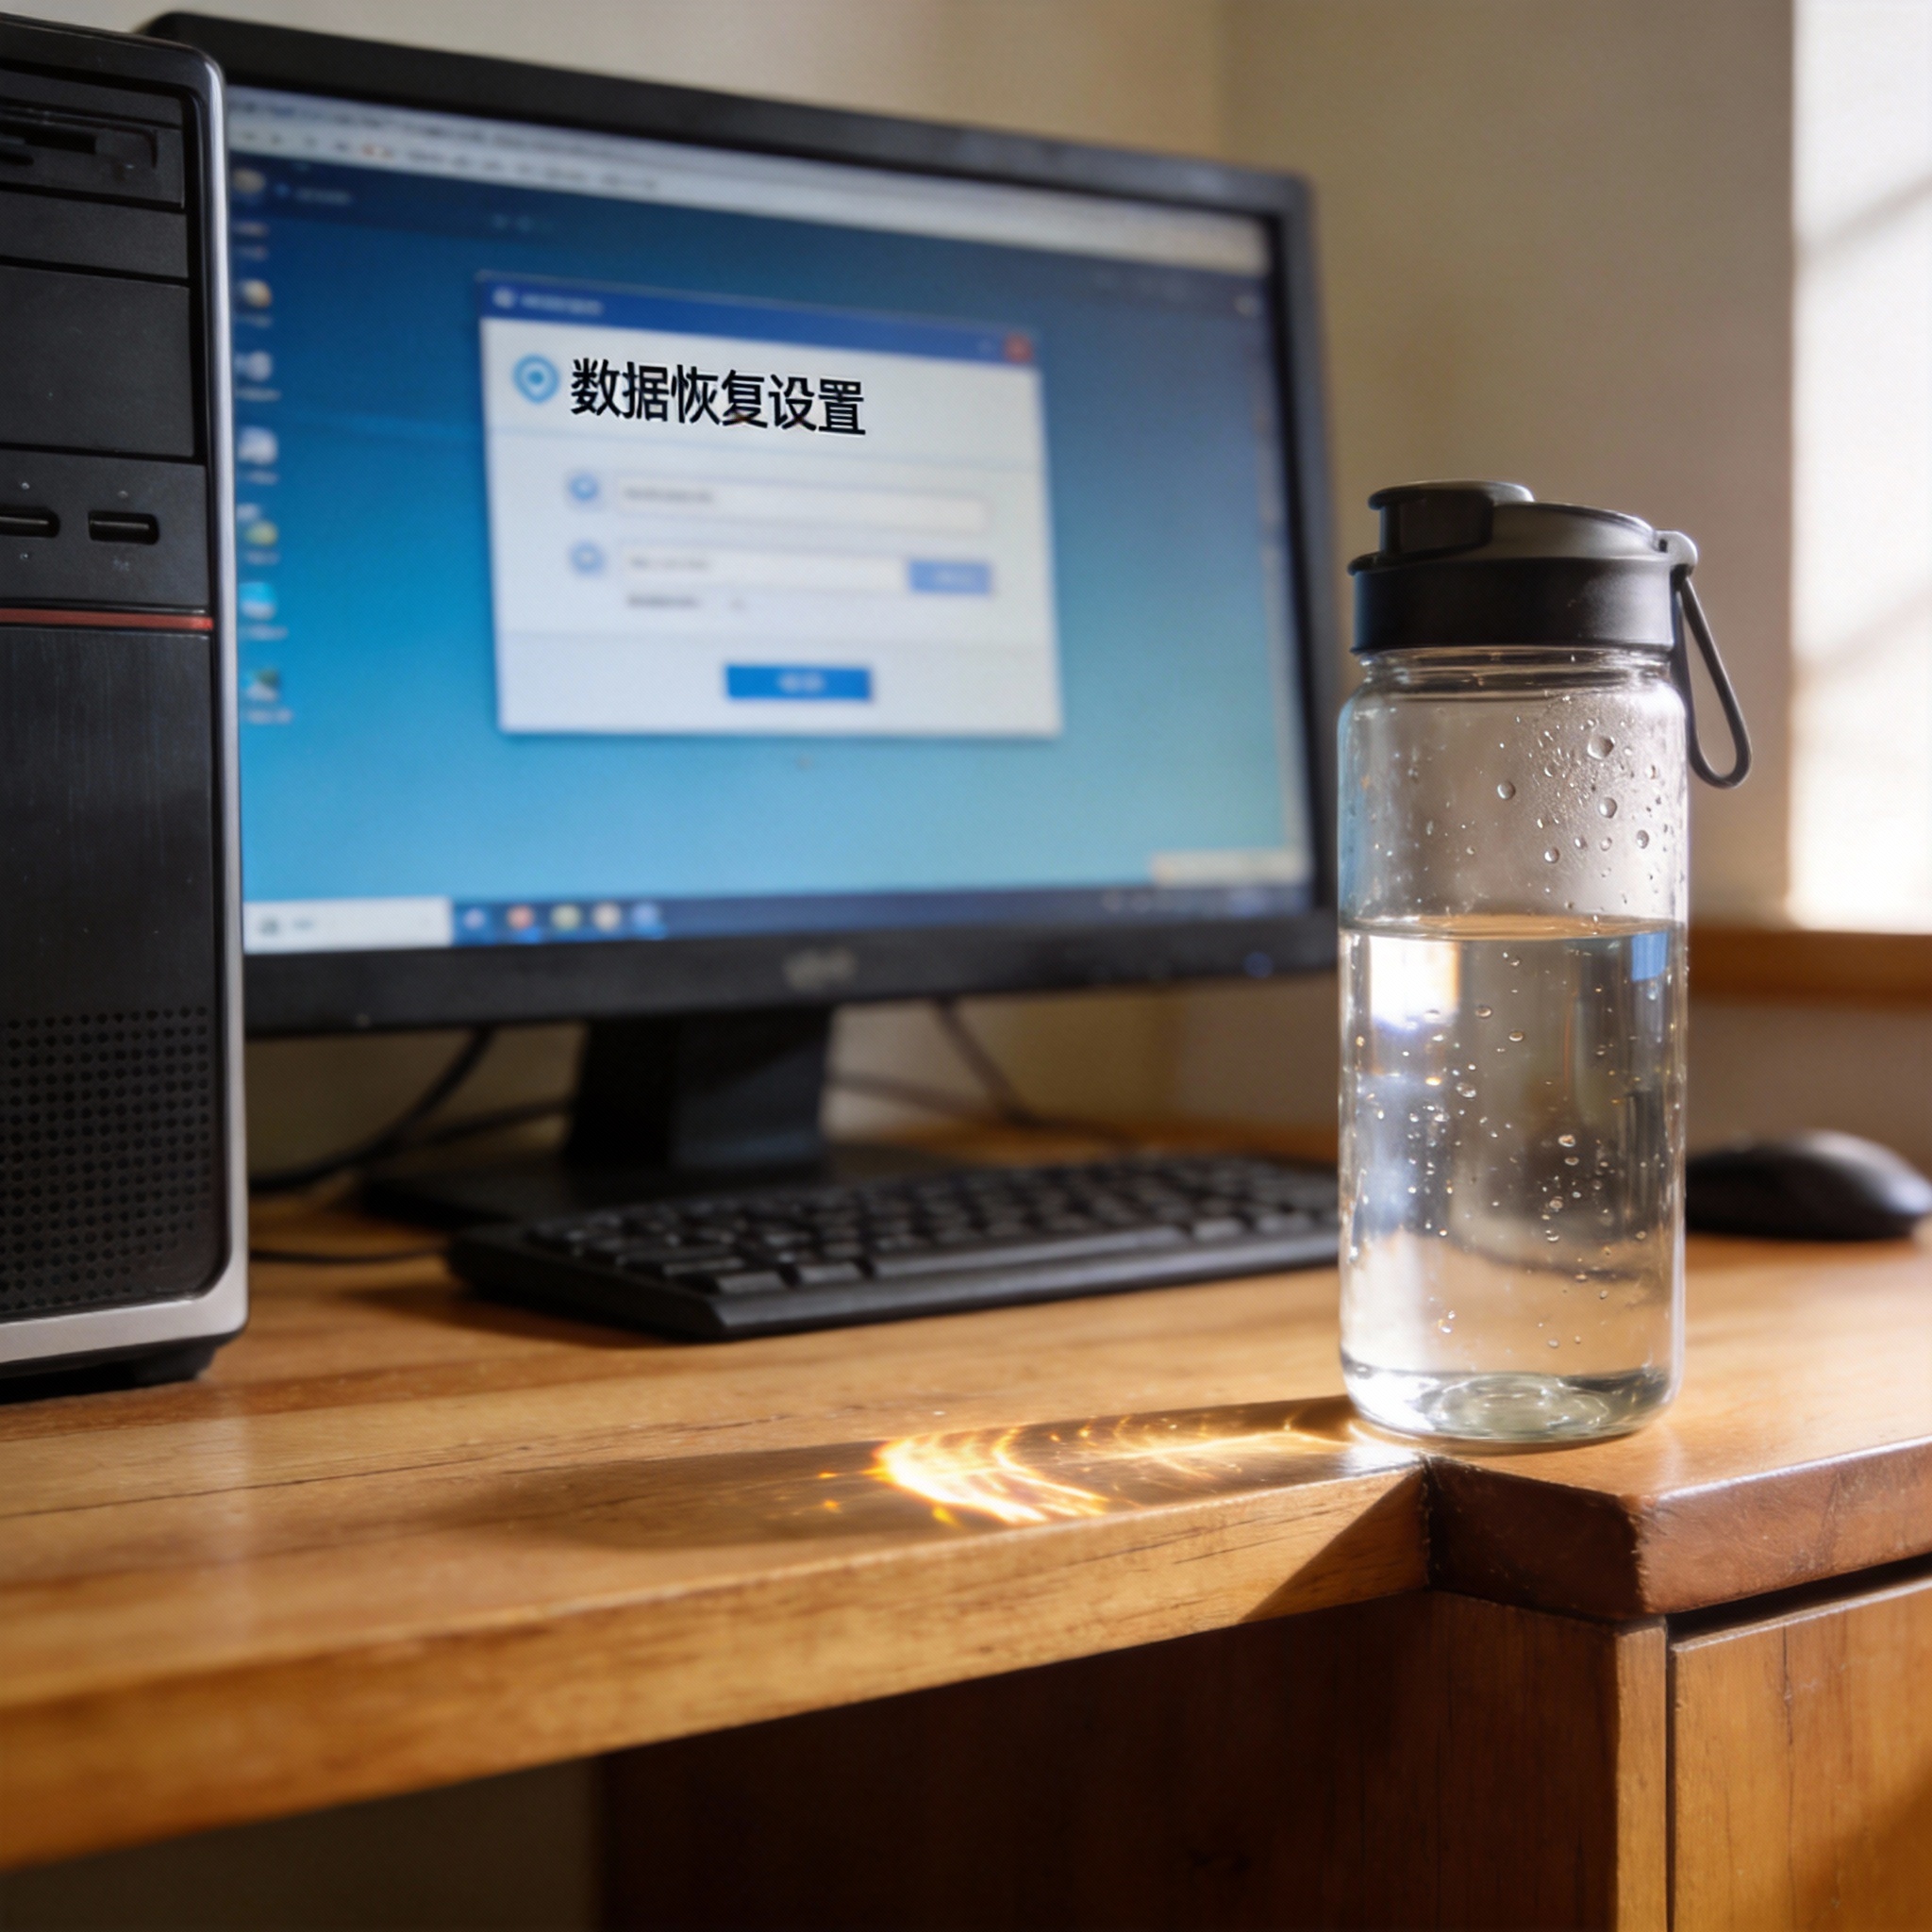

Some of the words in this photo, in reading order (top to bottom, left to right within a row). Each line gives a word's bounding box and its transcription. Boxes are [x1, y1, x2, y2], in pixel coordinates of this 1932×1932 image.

[570, 357, 866, 436] 数据恢复设置
